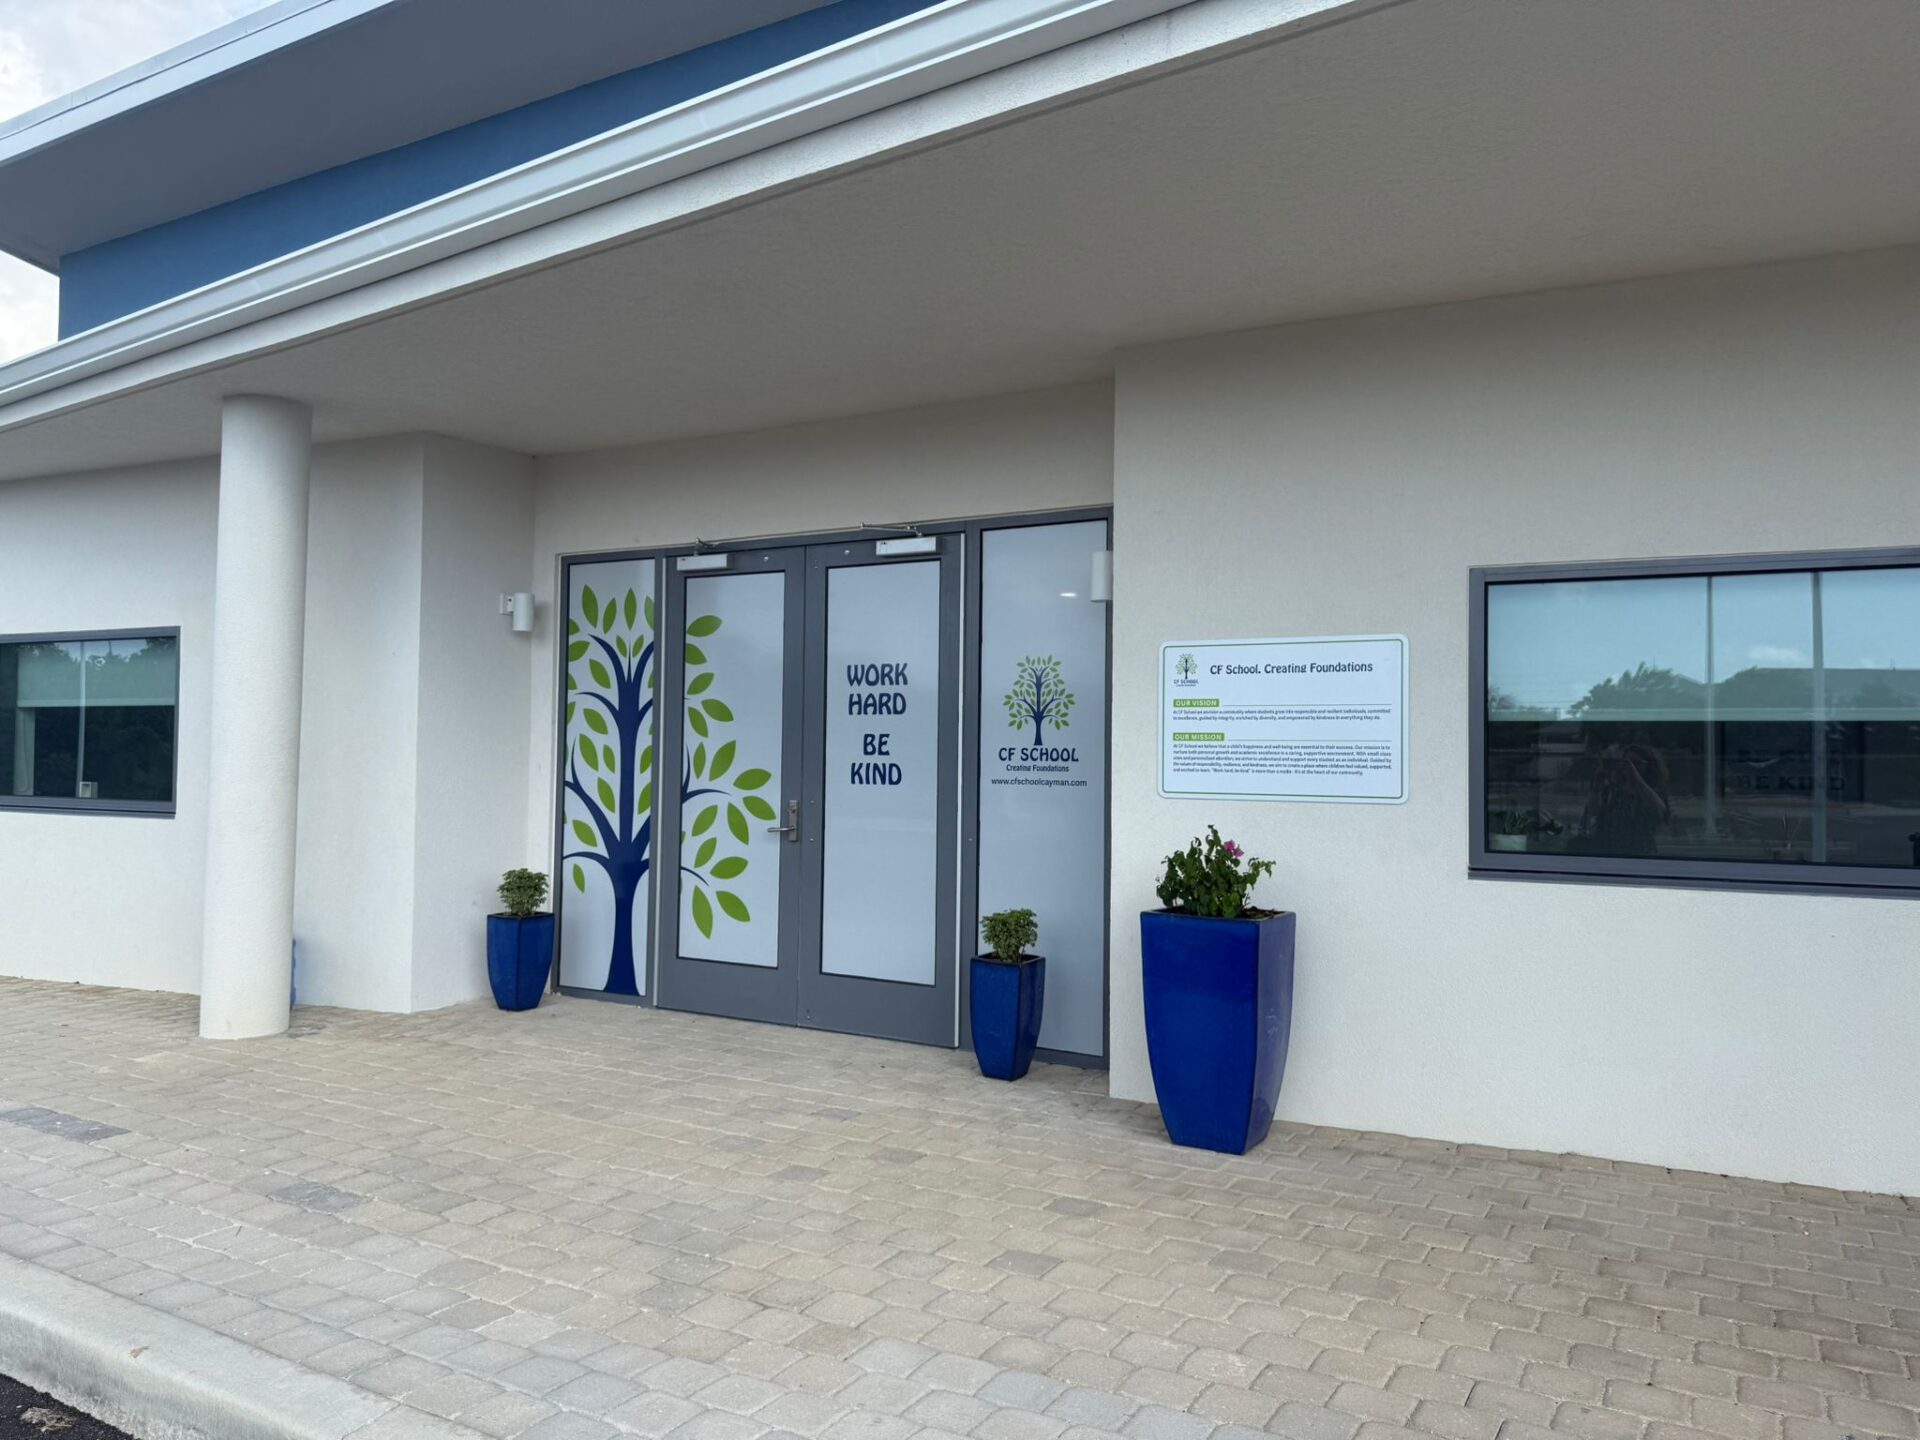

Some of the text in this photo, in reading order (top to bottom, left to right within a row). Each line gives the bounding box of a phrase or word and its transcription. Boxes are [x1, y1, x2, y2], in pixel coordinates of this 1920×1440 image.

[847, 663, 908, 687] WORK
[1210, 662, 1373, 675] CF School. Creating Foundations
[848, 693, 907, 716] HARD
[863, 733, 891, 756] BE
[998, 747, 1079, 762] CF SCHOOL
[851, 762, 902, 786] KIND
[1032, 764, 1070, 773] Foundations
[991, 776, 1087, 788] www.cfschoolcayman.com
